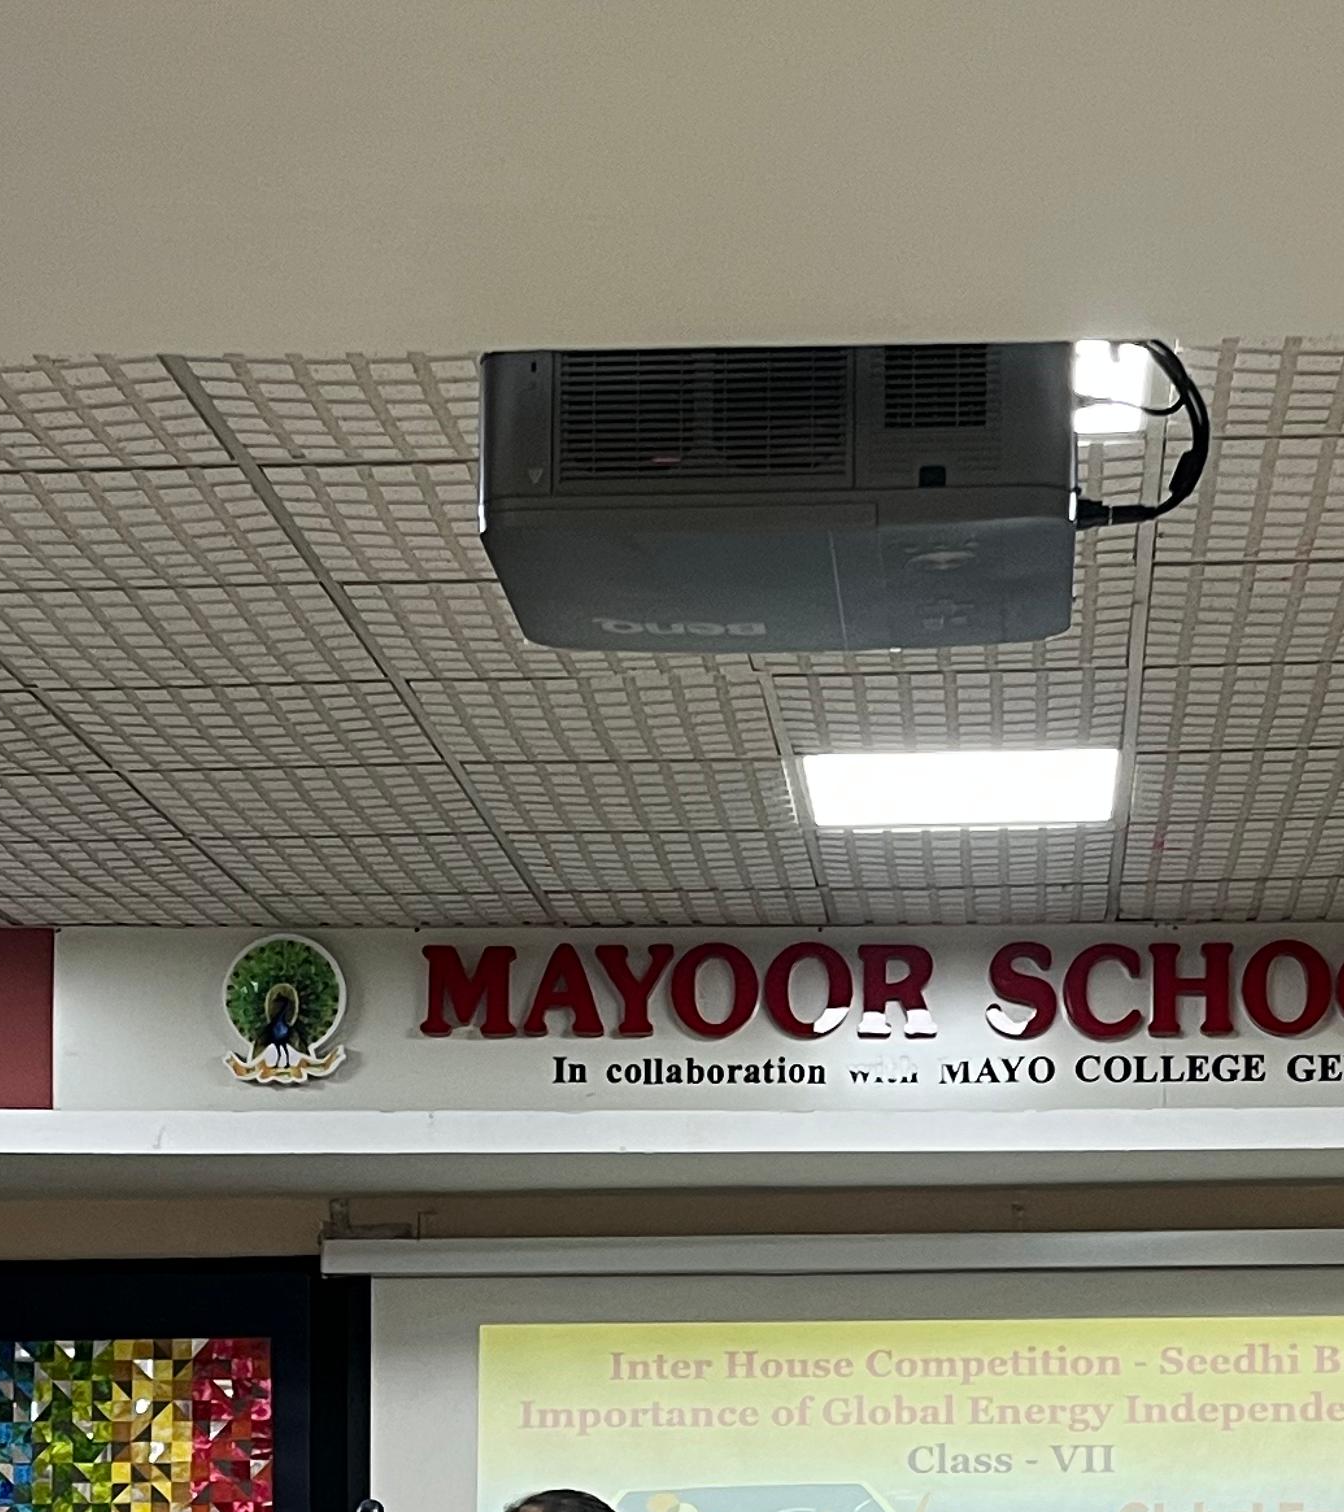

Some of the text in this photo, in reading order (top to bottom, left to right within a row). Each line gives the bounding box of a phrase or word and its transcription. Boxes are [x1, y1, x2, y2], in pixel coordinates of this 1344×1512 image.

[421, 941, 938, 1039] MAYOOR
[552, 1057, 587, 1084] In
[606, 1056, 827, 1085] collaboration
[938, 1056, 1056, 1084] MAYO
[1074, 1053, 1267, 1084] COLLEGE
[609, 1350, 713, 1381] Inter
[724, 1350, 854, 1380] House
[865, 1346, 1122, 1385] Competition
[1159, 1343, 1301, 1376] Seedhi
[519, 1398, 759, 1437] Importance
[771, 1395, 815, 1428] of
[822, 1393, 955, 1427] Global
[969, 1395, 1115, 1432] Energy
[907, 1443, 1014, 1475] Class
[1050, 1444, 1116, 1474] VII
